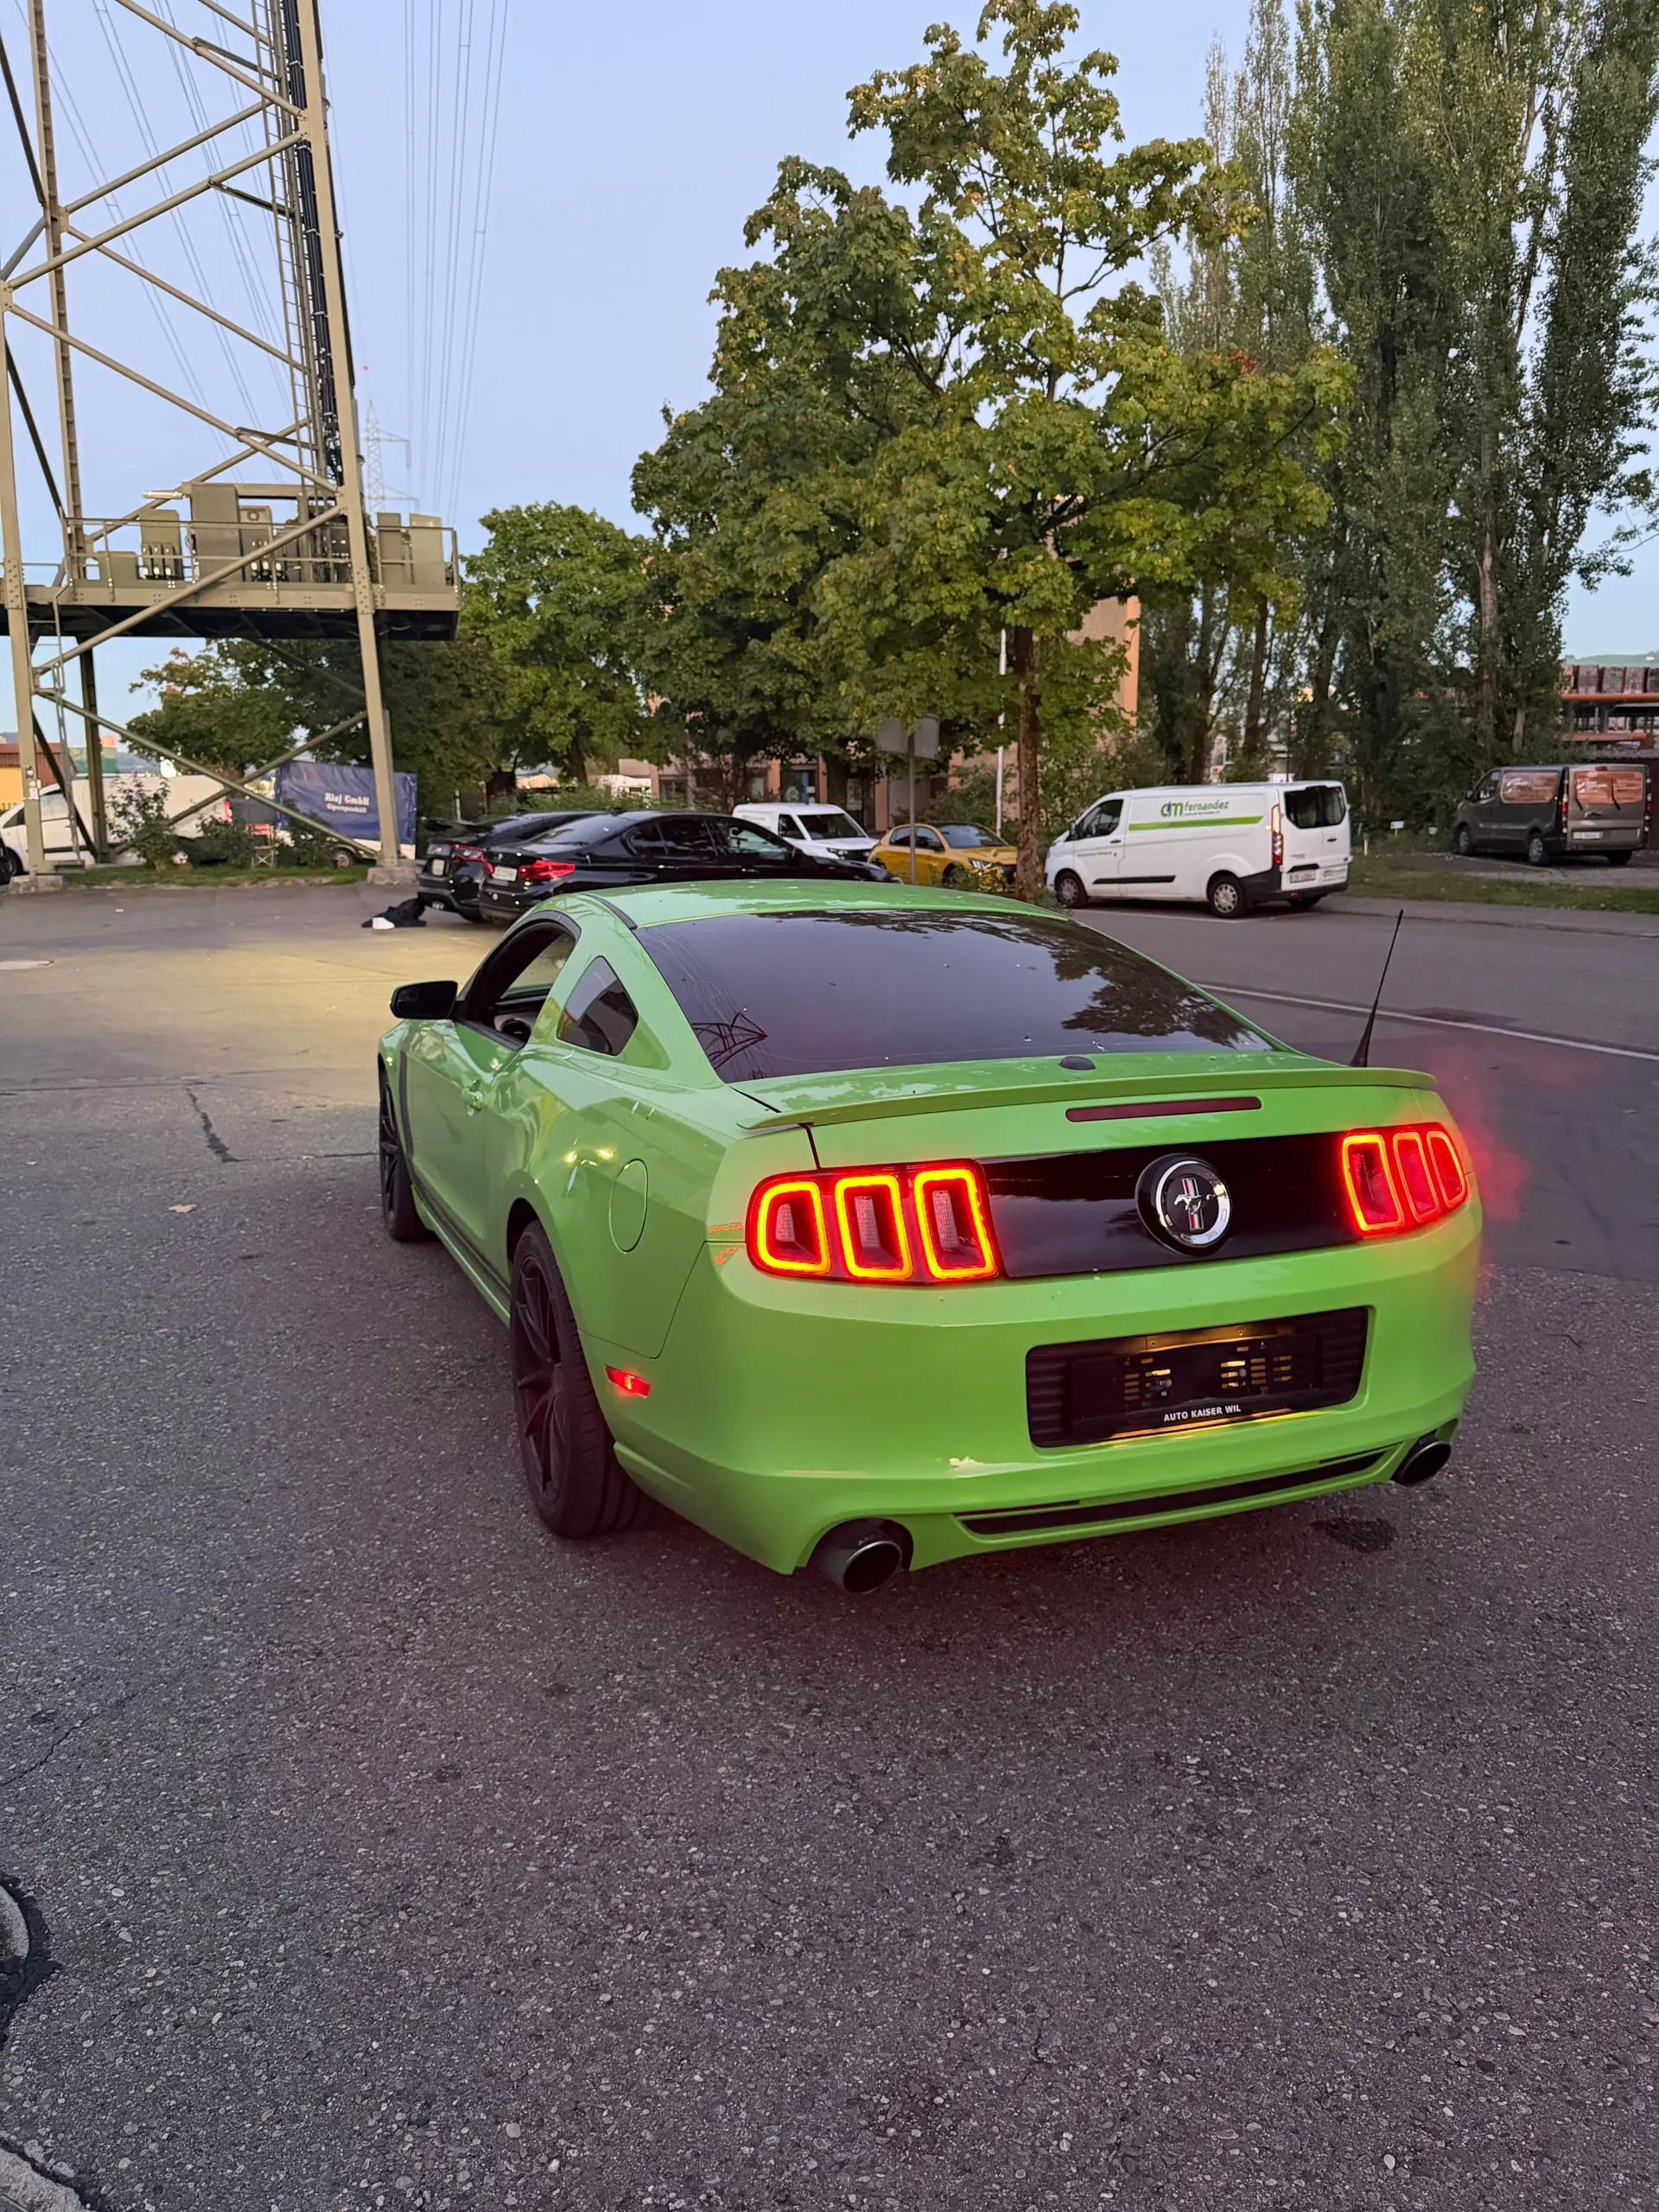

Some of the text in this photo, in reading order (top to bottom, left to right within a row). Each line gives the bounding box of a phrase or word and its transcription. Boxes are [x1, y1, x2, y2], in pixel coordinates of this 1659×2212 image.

[1185, 799, 1229, 810] fernandez
[1163, 1404, 1242, 1422] AUTO KAISER WIL
